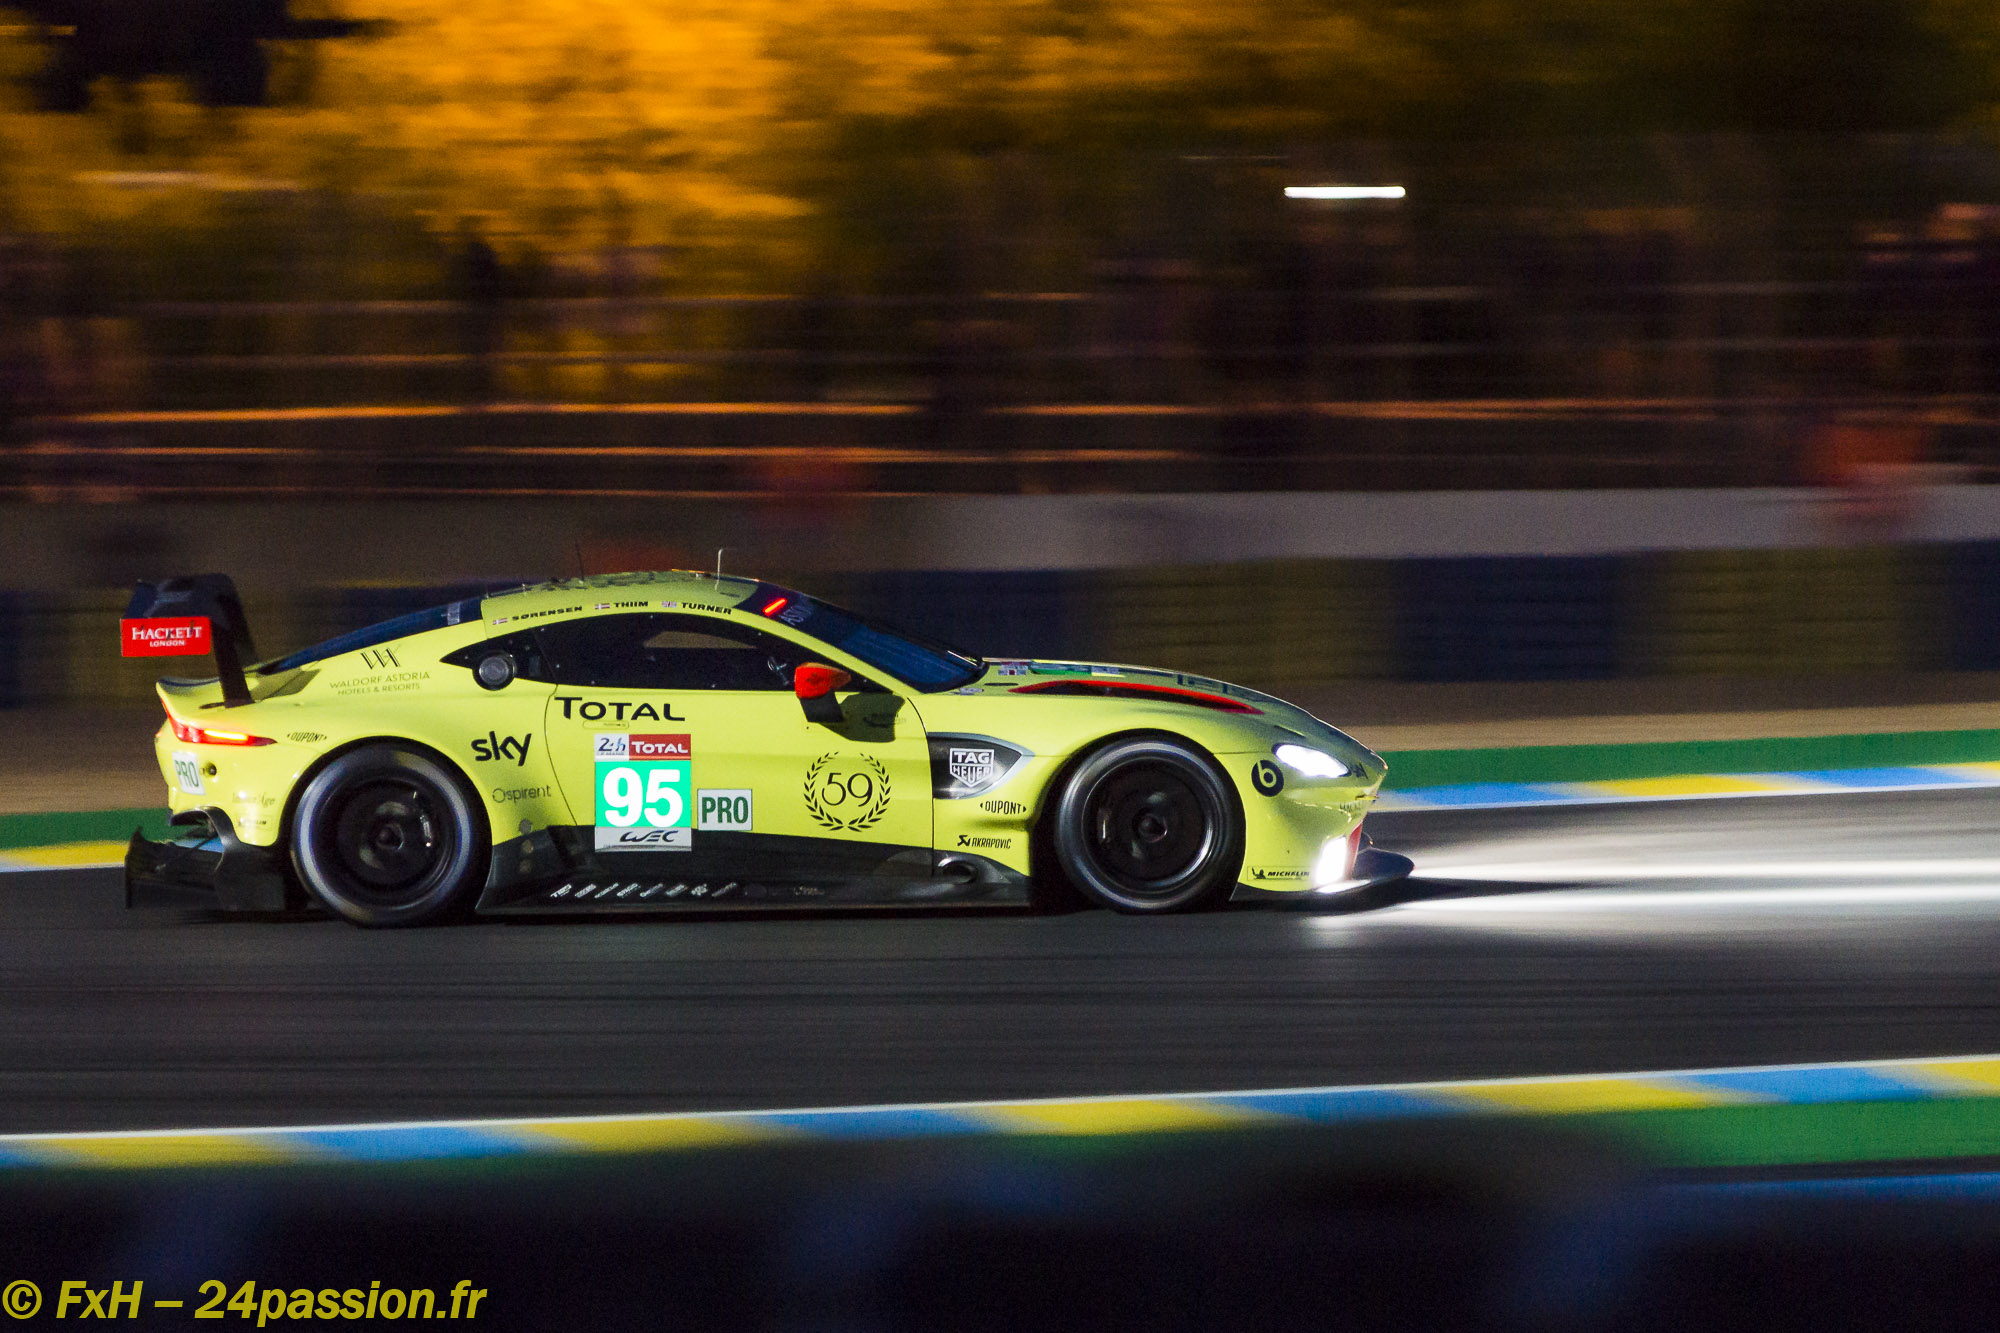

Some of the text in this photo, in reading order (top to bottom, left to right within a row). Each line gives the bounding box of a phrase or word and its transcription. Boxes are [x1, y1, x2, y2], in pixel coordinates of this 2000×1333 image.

[681, 602, 732, 615] TURNER
[132, 627, 202, 640] HACKETT
[149, 640, 186, 648] LONDON
[329, 671, 430, 689] WALDORF ASTORIA
[338, 687, 371, 695] HOTELS
[382, 682, 420, 692] RESORTS
[554, 697, 685, 721] TOTAL
[471, 730, 532, 767] sky
[631, 741, 688, 754] TOTAL
[954, 752, 990, 764] TAG
[174, 759, 199, 788] PRO
[953, 766, 990, 783] HEUER
[504, 785, 551, 804] spirent
[603, 767, 683, 828] 95
[821, 772, 873, 807] 59
[701, 796, 749, 824] PRO
[984, 800, 1021, 815] DUPONT
[619, 830, 679, 843] WEC
